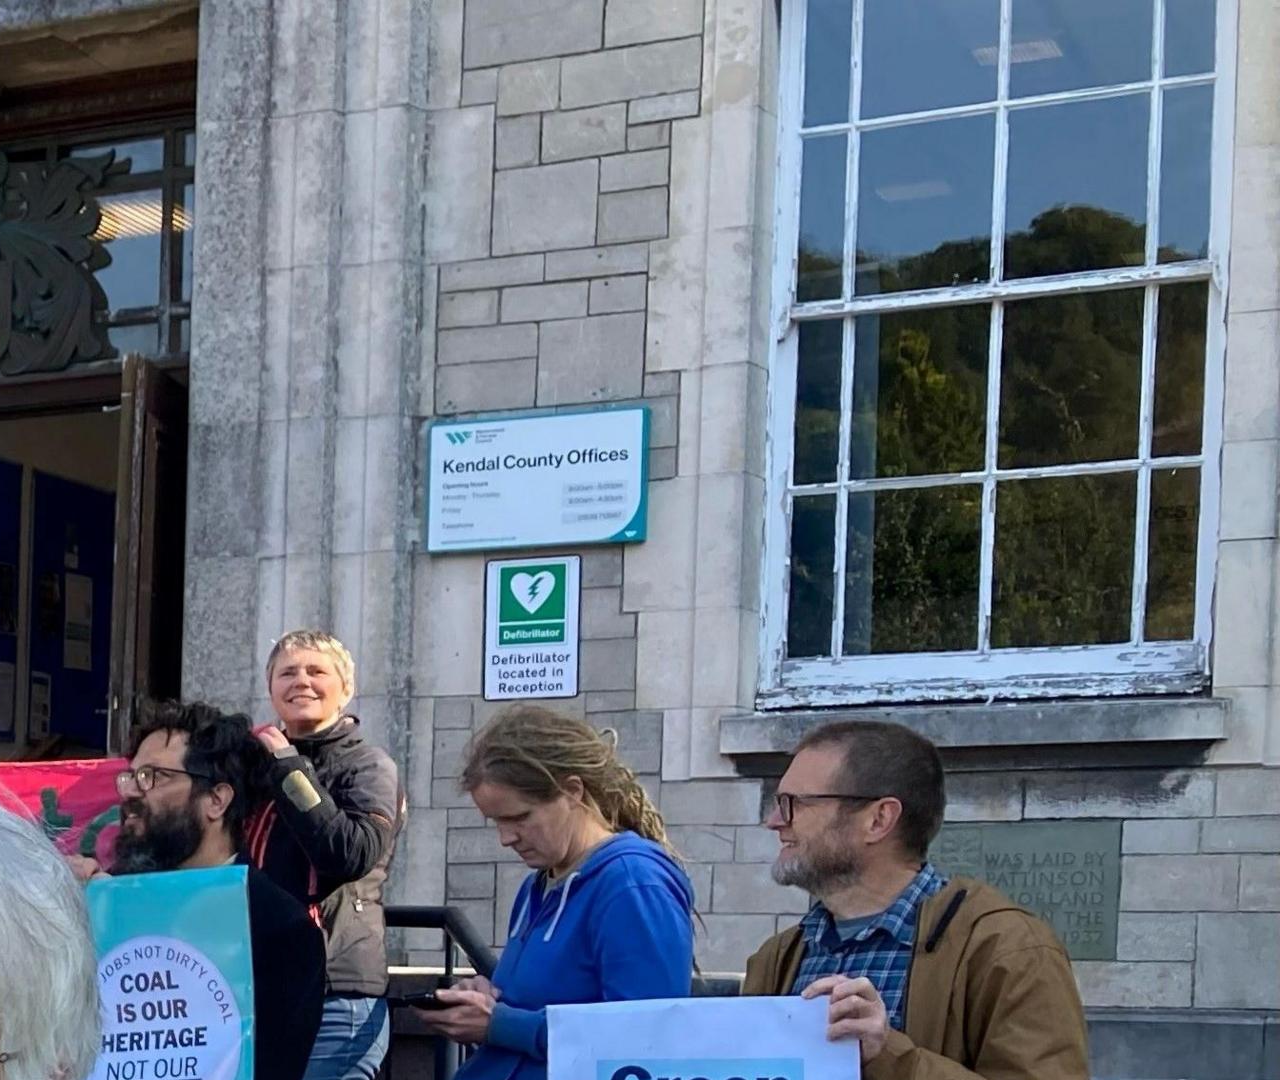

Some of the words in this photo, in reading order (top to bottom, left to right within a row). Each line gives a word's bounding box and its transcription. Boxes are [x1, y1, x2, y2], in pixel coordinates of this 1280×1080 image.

[443, 456, 500, 474] Kendal
[503, 453, 563, 470] County
[567, 447, 629, 465] Offices
[503, 626, 560, 641] Defibrillator
[491, 652, 571, 666] Defibrillator
[498, 667, 547, 679] located
[552, 666, 564, 677] in
[498, 680, 563, 694] Reception
[985, 852, 1024, 867] WAS
[1032, 851, 1076, 866] LAID
[1084, 851, 1106, 866] BY
[987, 870, 1105, 887] PATTINSON
[1065, 911, 1104, 926] THE
[100, 954, 132, 984] JOBS
[134, 945, 162, 961] NOT
[166, 948, 209, 980] DIRTY
[207, 979, 233, 1025] COAL
[120, 970, 180, 994] COAL
[116, 1003, 137, 1024] IS
[141, 998, 188, 1021] OUR
[101, 1026, 208, 1053] HERITAGE
[154, 1056, 198, 1078] OUR
